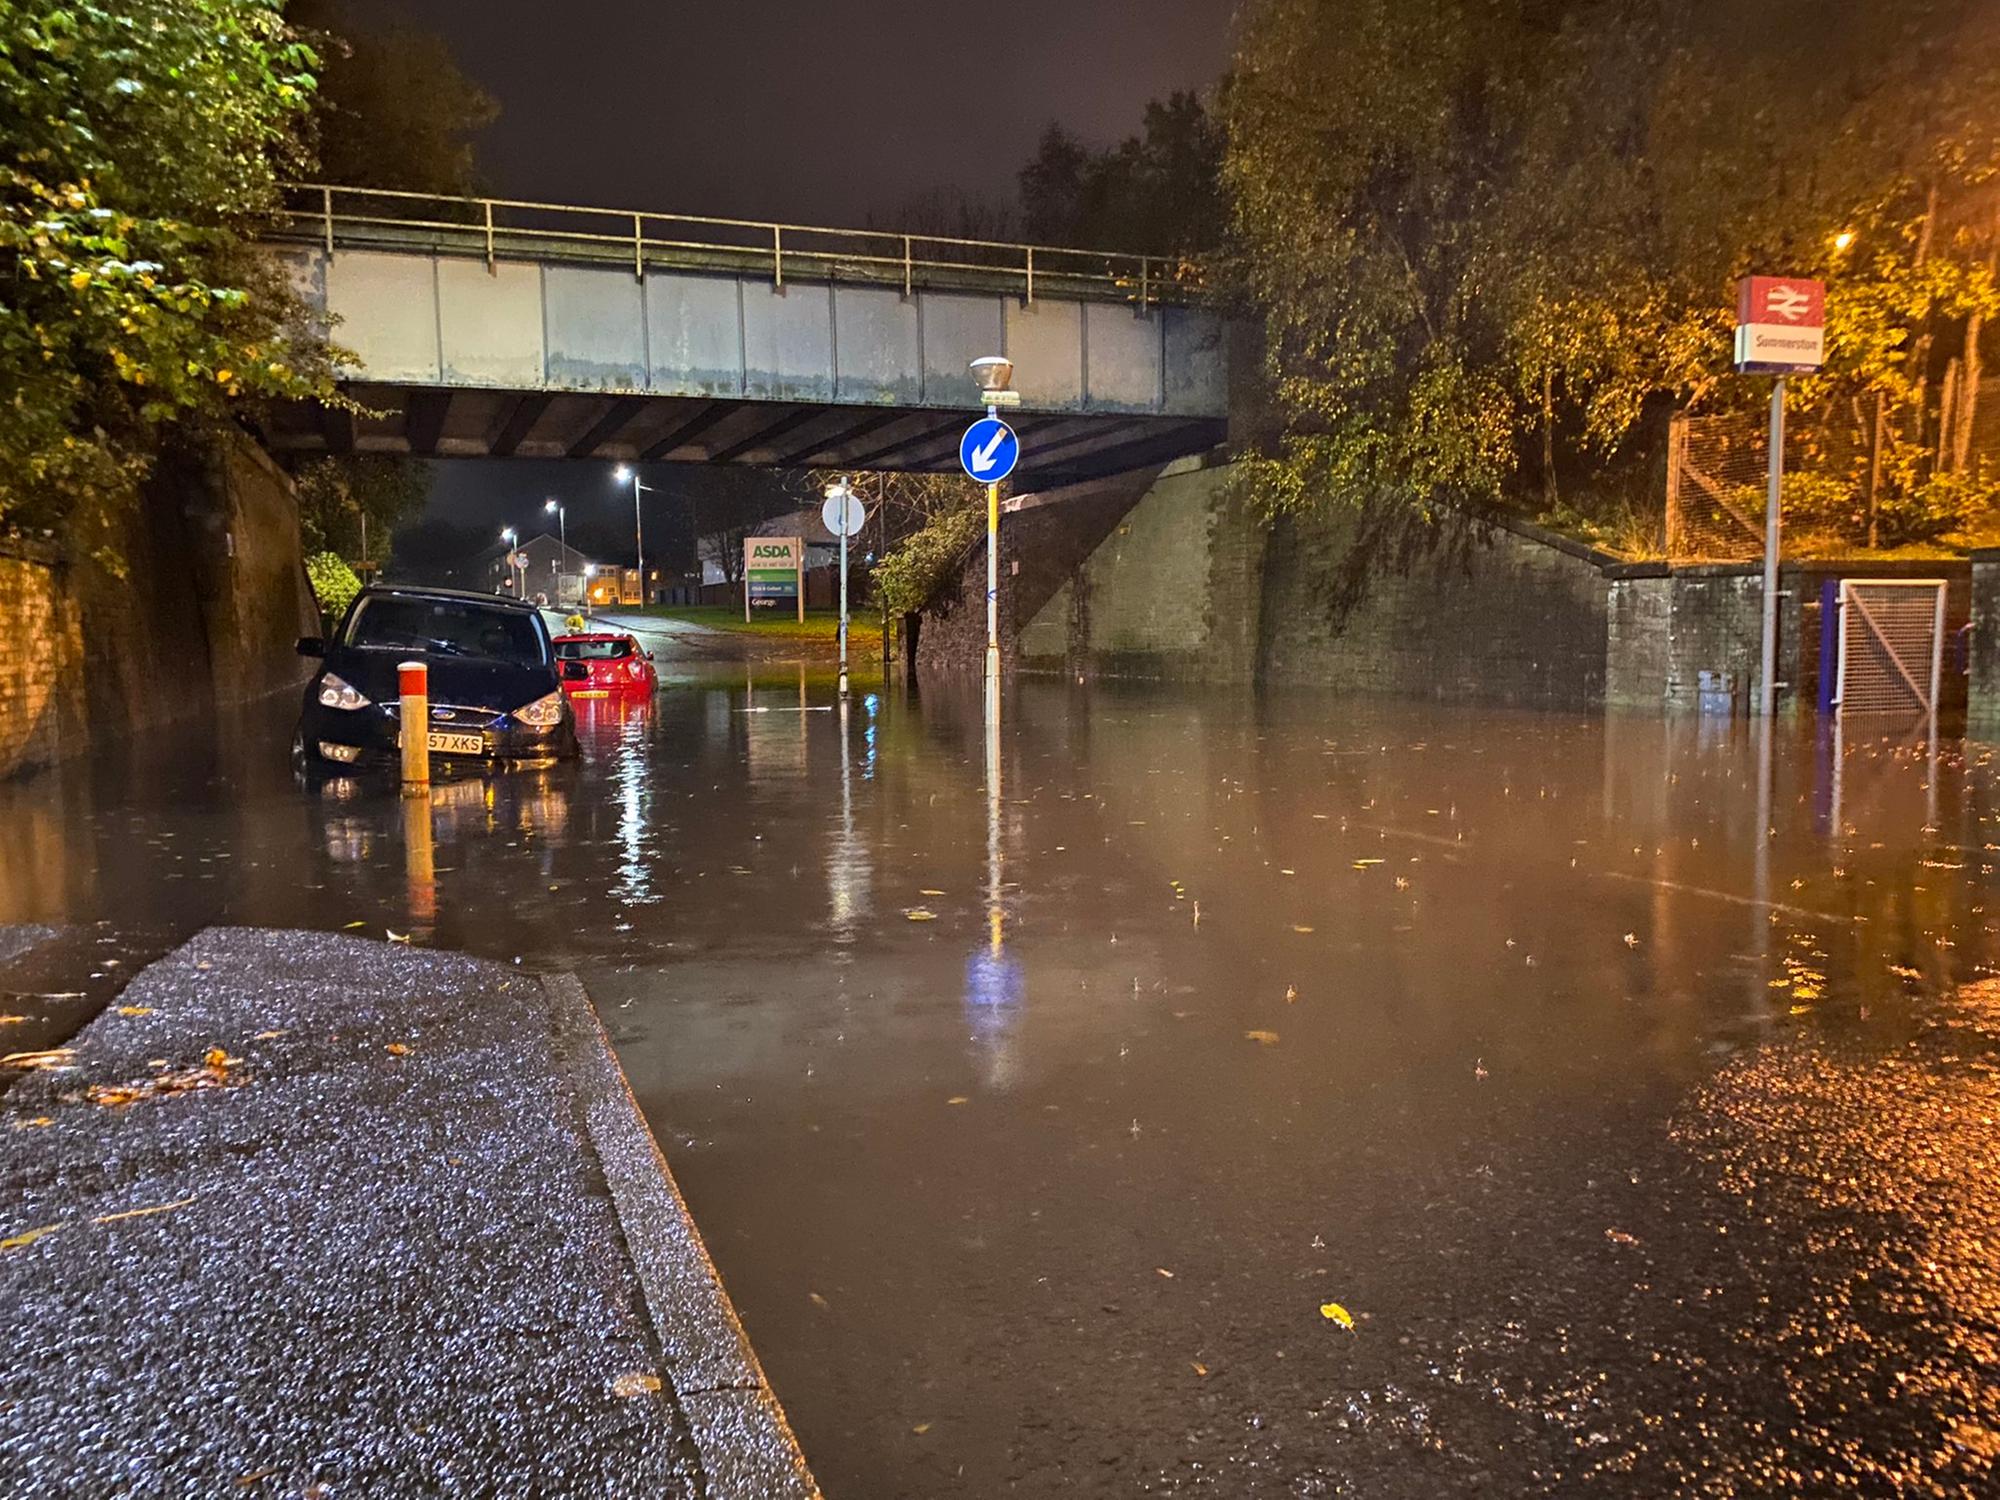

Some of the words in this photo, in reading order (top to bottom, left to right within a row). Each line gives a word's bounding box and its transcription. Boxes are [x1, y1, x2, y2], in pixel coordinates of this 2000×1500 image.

[1756, 334, 1818, 350] Summerston
[753, 545, 791, 558] ASDA
[451, 737, 480, 751] XKS
